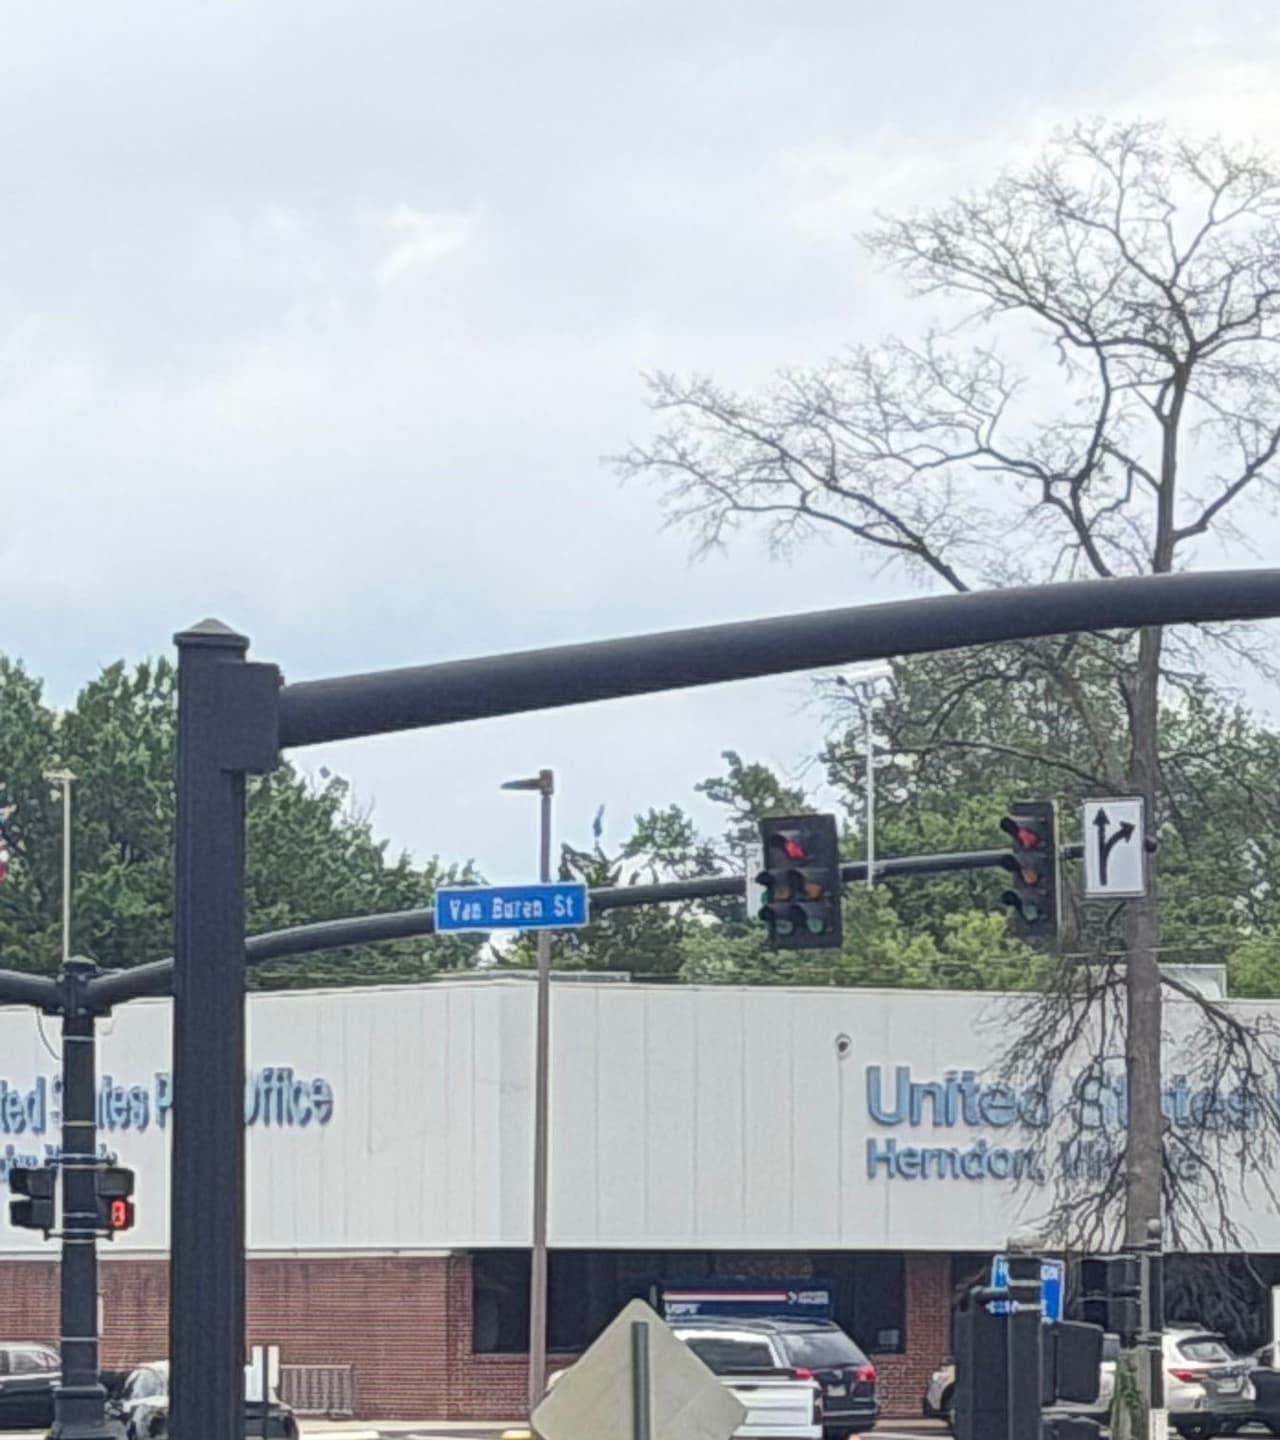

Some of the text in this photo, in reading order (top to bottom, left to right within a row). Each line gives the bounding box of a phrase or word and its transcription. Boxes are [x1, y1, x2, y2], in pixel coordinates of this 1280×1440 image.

[450, 894, 574, 921] Van Buren St
[866, 1065, 1050, 1128] United
